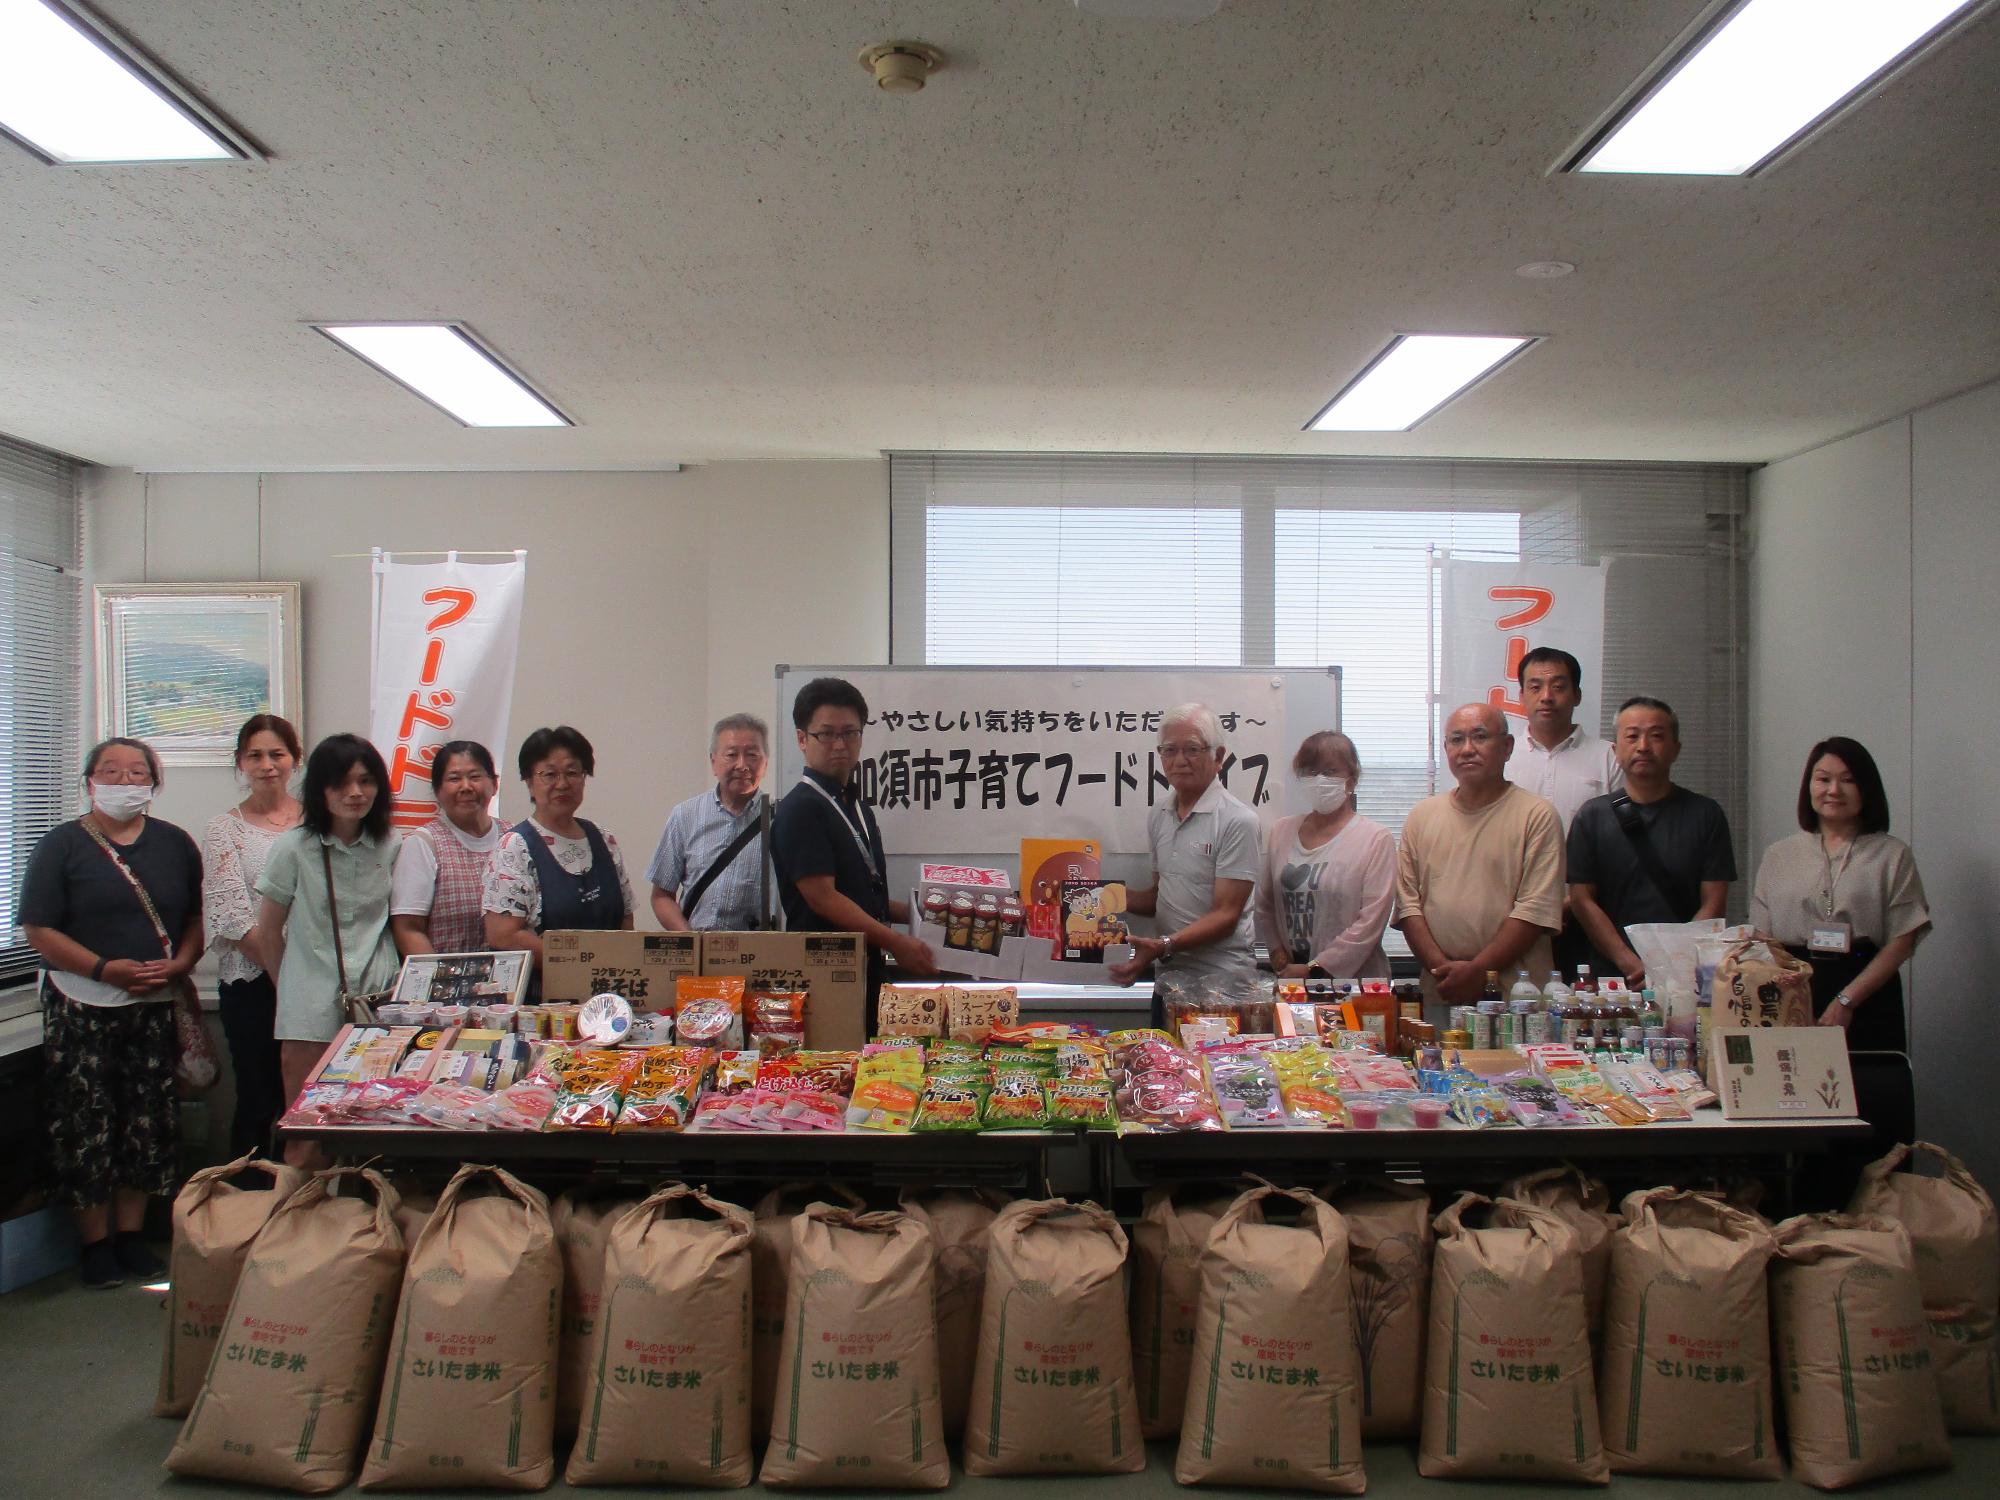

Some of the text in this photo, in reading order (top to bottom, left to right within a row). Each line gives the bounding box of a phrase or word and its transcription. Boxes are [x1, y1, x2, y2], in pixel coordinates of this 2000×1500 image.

[850, 747, 1270, 812] 加須市子育てフードドイブ
[580, 951, 596, 964] BP
[740, 953, 756, 965] BP
[591, 967, 642, 978] コク旨ソース
[751, 968, 804, 979] コク旨ソース
[590, 977, 650, 998] 焼そば
[888, 1000, 922, 1012] スープ
[961, 1001, 996, 1012] スープ
[886, 1012, 935, 1026] はるさめ
[960, 1014, 1011, 1026] はるさめ
[226, 1342, 308, 1373] さいたま米
[412, 1358, 503, 1382] さいたま米
[614, 1365, 702, 1389] さいたま米
[811, 1360, 901, 1381] さいたま米
[1014, 1365, 1101, 1387] さいたま米
[1230, 1360, 1321, 1387] さいたま米
[1470, 1359, 1561, 1382] さいたま米
[1656, 1358, 1745, 1383] さいたま米
